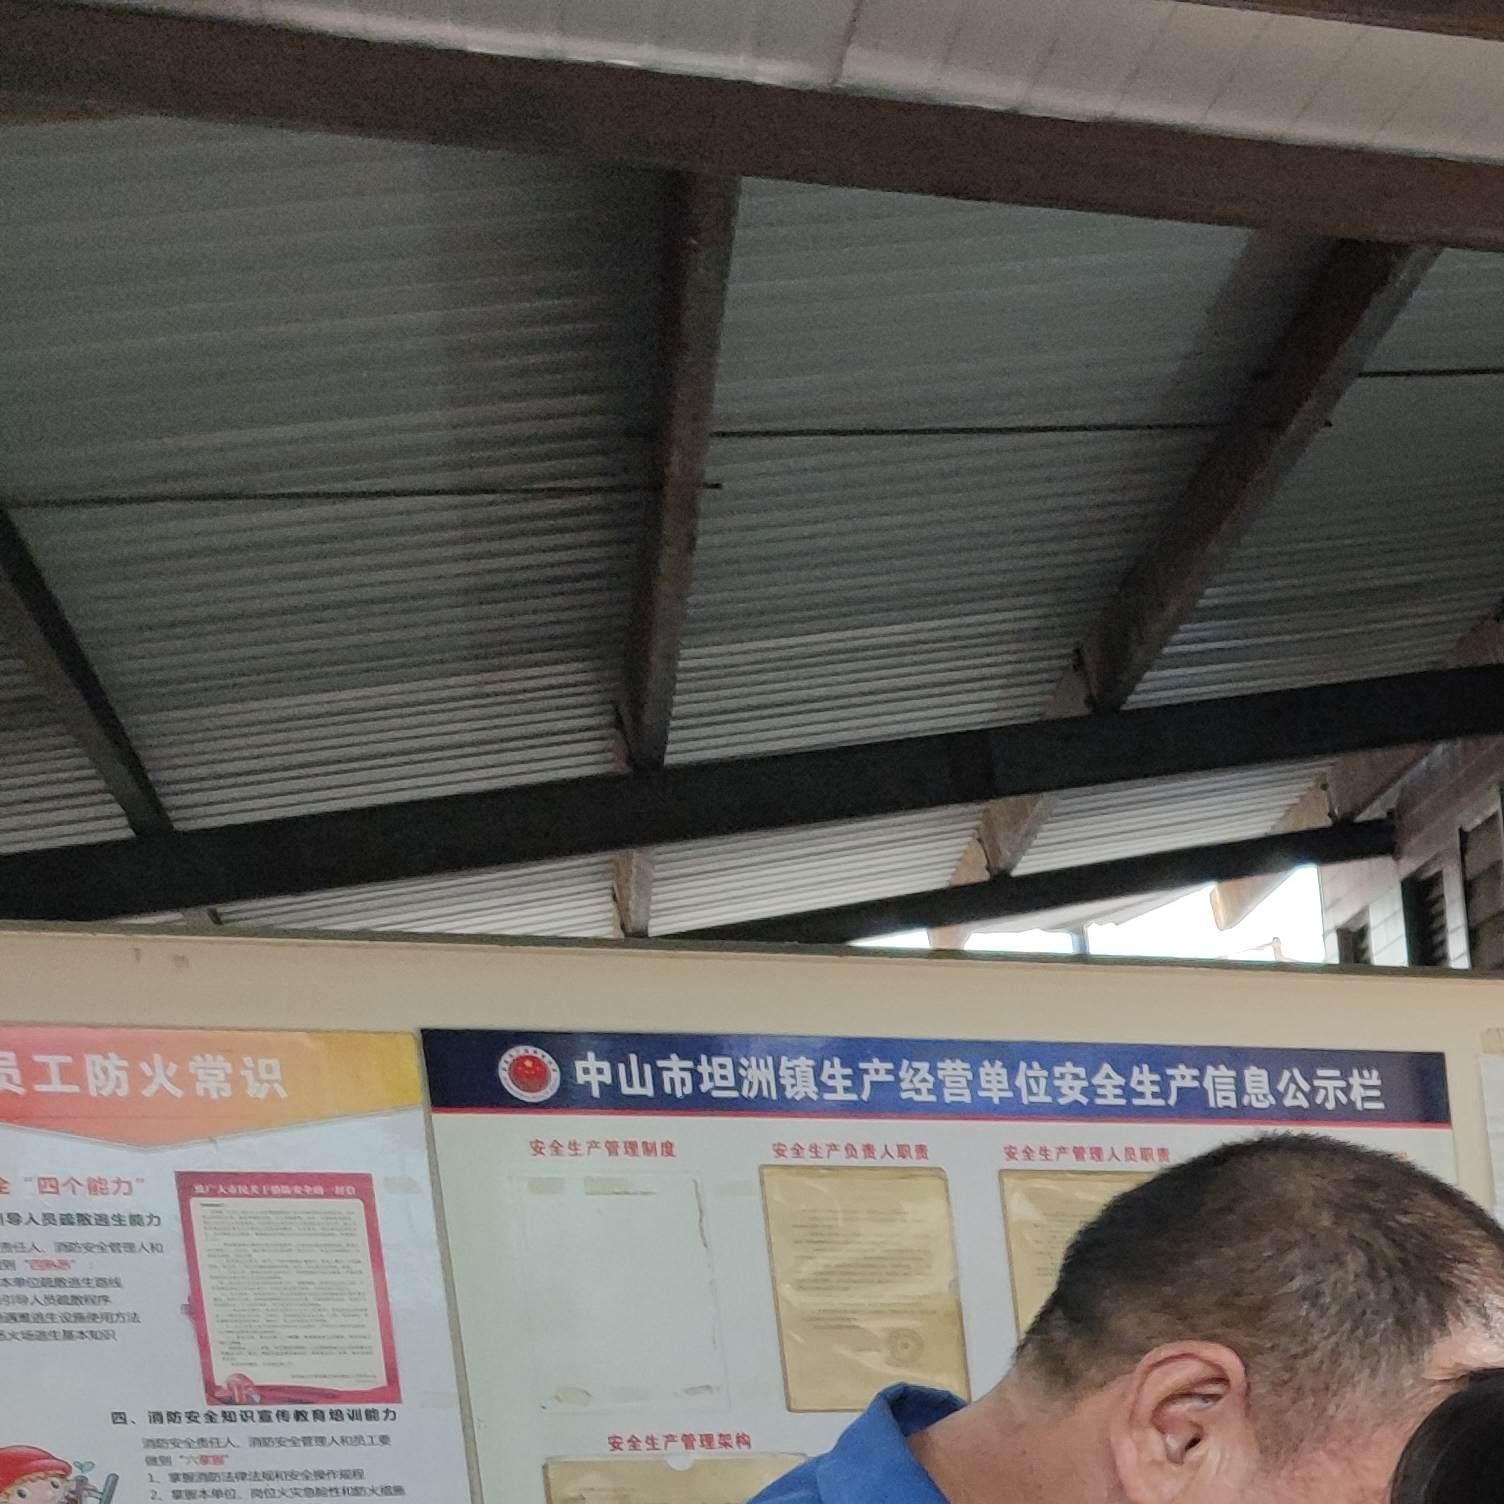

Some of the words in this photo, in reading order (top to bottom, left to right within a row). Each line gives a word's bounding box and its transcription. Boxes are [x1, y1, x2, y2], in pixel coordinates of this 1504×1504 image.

[0, 1052, 289, 1099] 员工防火常识
[574, 1052, 1385, 1110] 中山市坦洲镇生产经营单位安全生产信息公示栏
[529, 1139, 675, 1157] 安全生产管理制度
[772, 1142, 928, 1160] 安全生产负责人职责
[0, 1211, 161, 1227] 导人员疏散逃生能力
[608, 1432, 752, 1451] 安全生产管理架构
